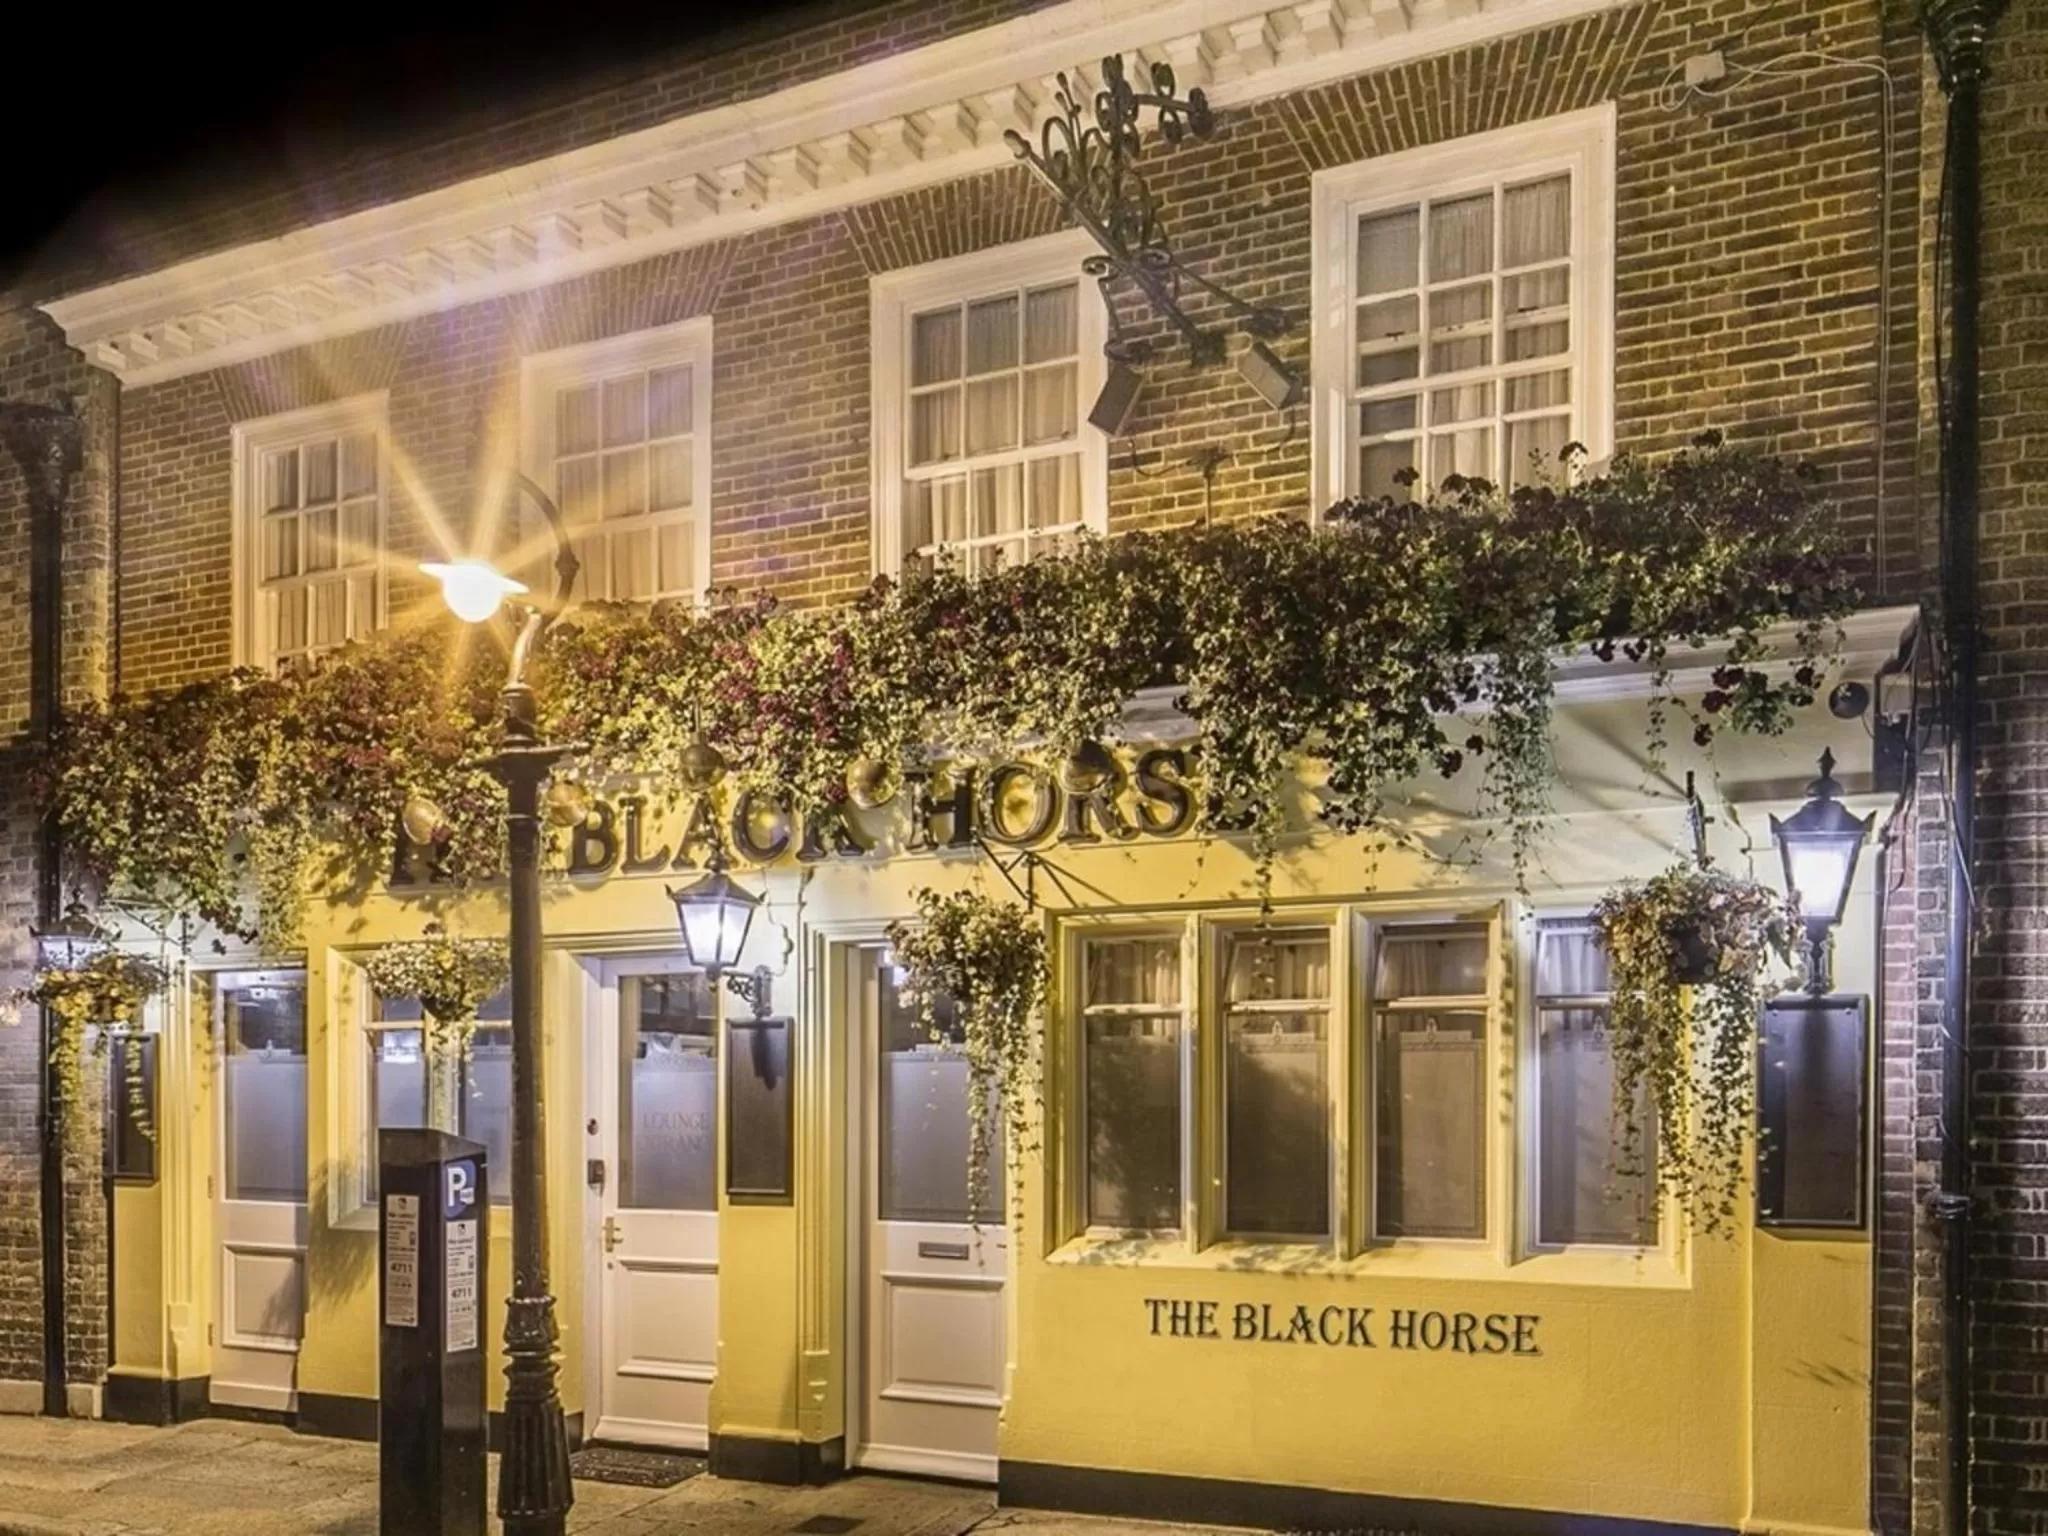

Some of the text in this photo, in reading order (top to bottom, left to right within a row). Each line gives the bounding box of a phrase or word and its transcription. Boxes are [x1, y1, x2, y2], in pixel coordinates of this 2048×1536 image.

[447, 1166, 467, 1207] P
[391, 1262, 413, 1273] 4711
[451, 1286, 472, 1298] 4711
[1144, 1298, 1543, 1357] THE BLACK HORSE
